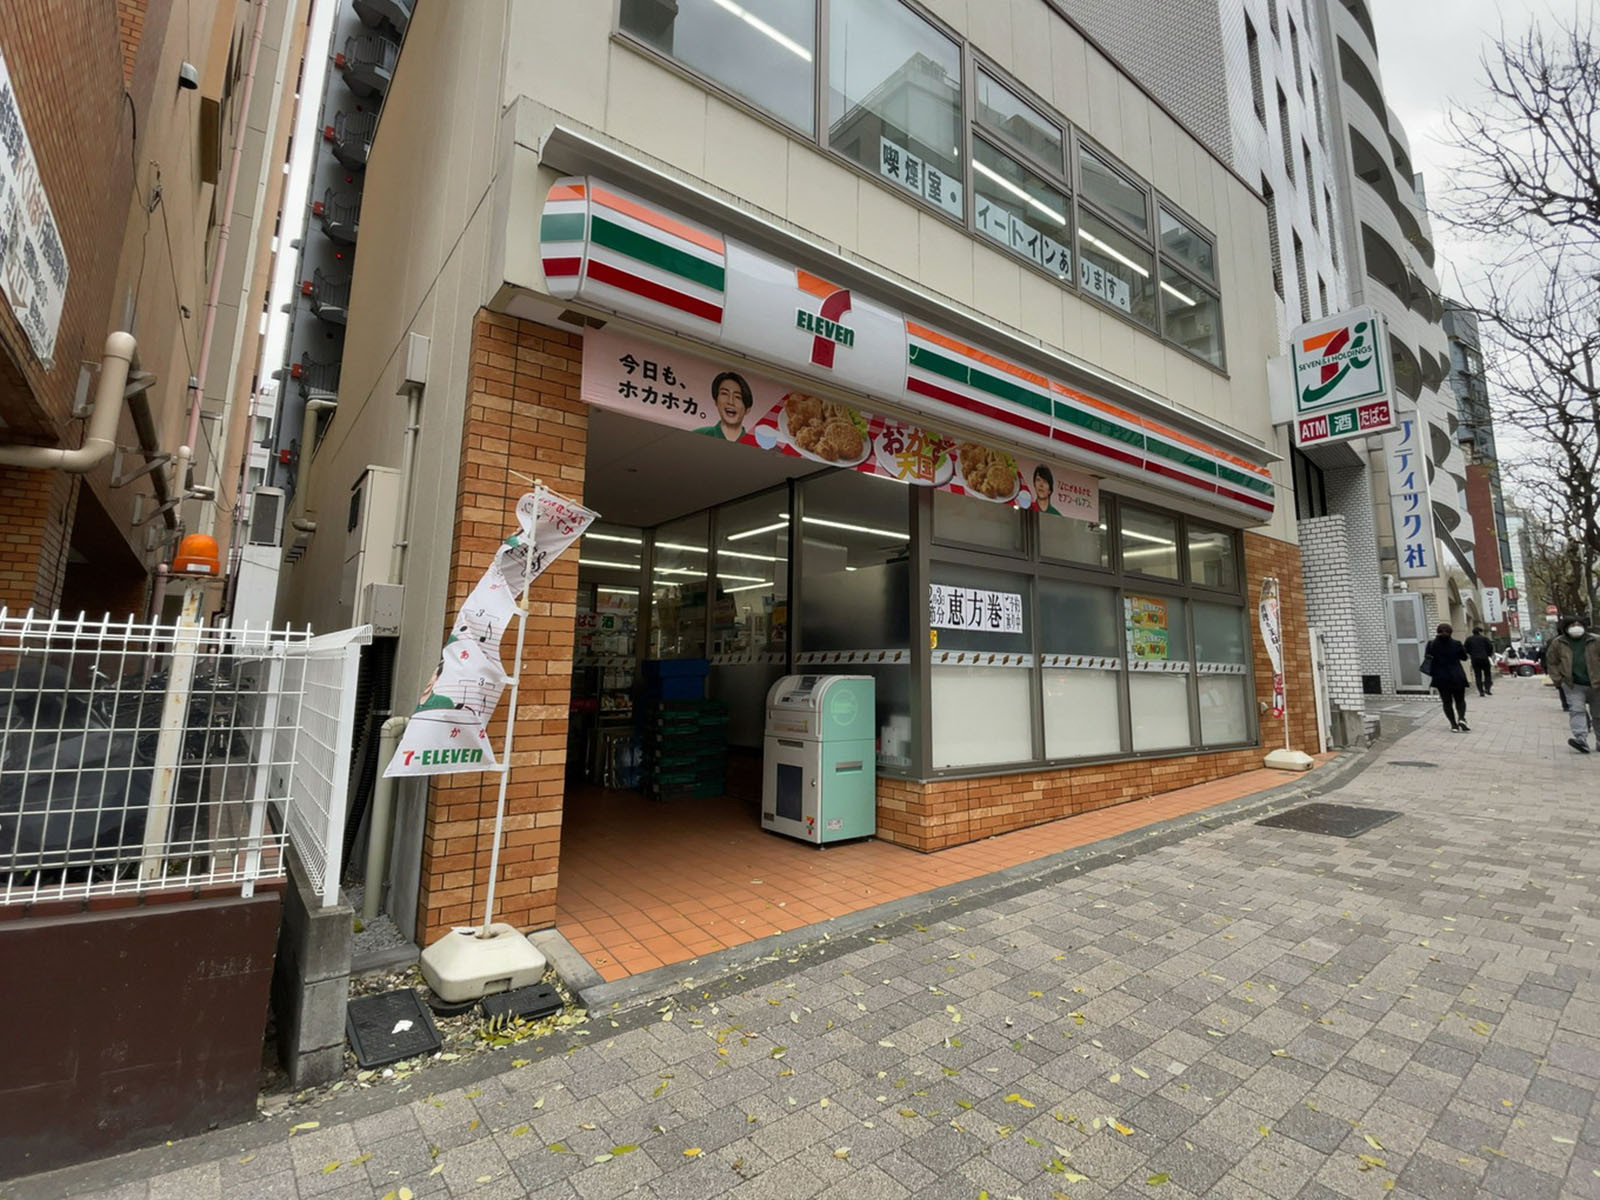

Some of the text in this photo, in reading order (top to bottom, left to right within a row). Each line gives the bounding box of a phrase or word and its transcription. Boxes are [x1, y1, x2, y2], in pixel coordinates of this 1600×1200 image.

[1331, 345, 1373, 362] HOLDINGS
[618, 353, 687, 390] 今日も、
[618, 380, 707, 420] ホカホカ。
[1334, 413, 1353, 433] 酒
[1360, 406, 1389, 426] たばこ
[1302, 420, 1327, 440] ATM
[895, 452, 937, 483] 天国
[947, 588, 1002, 628] 恵方巻
